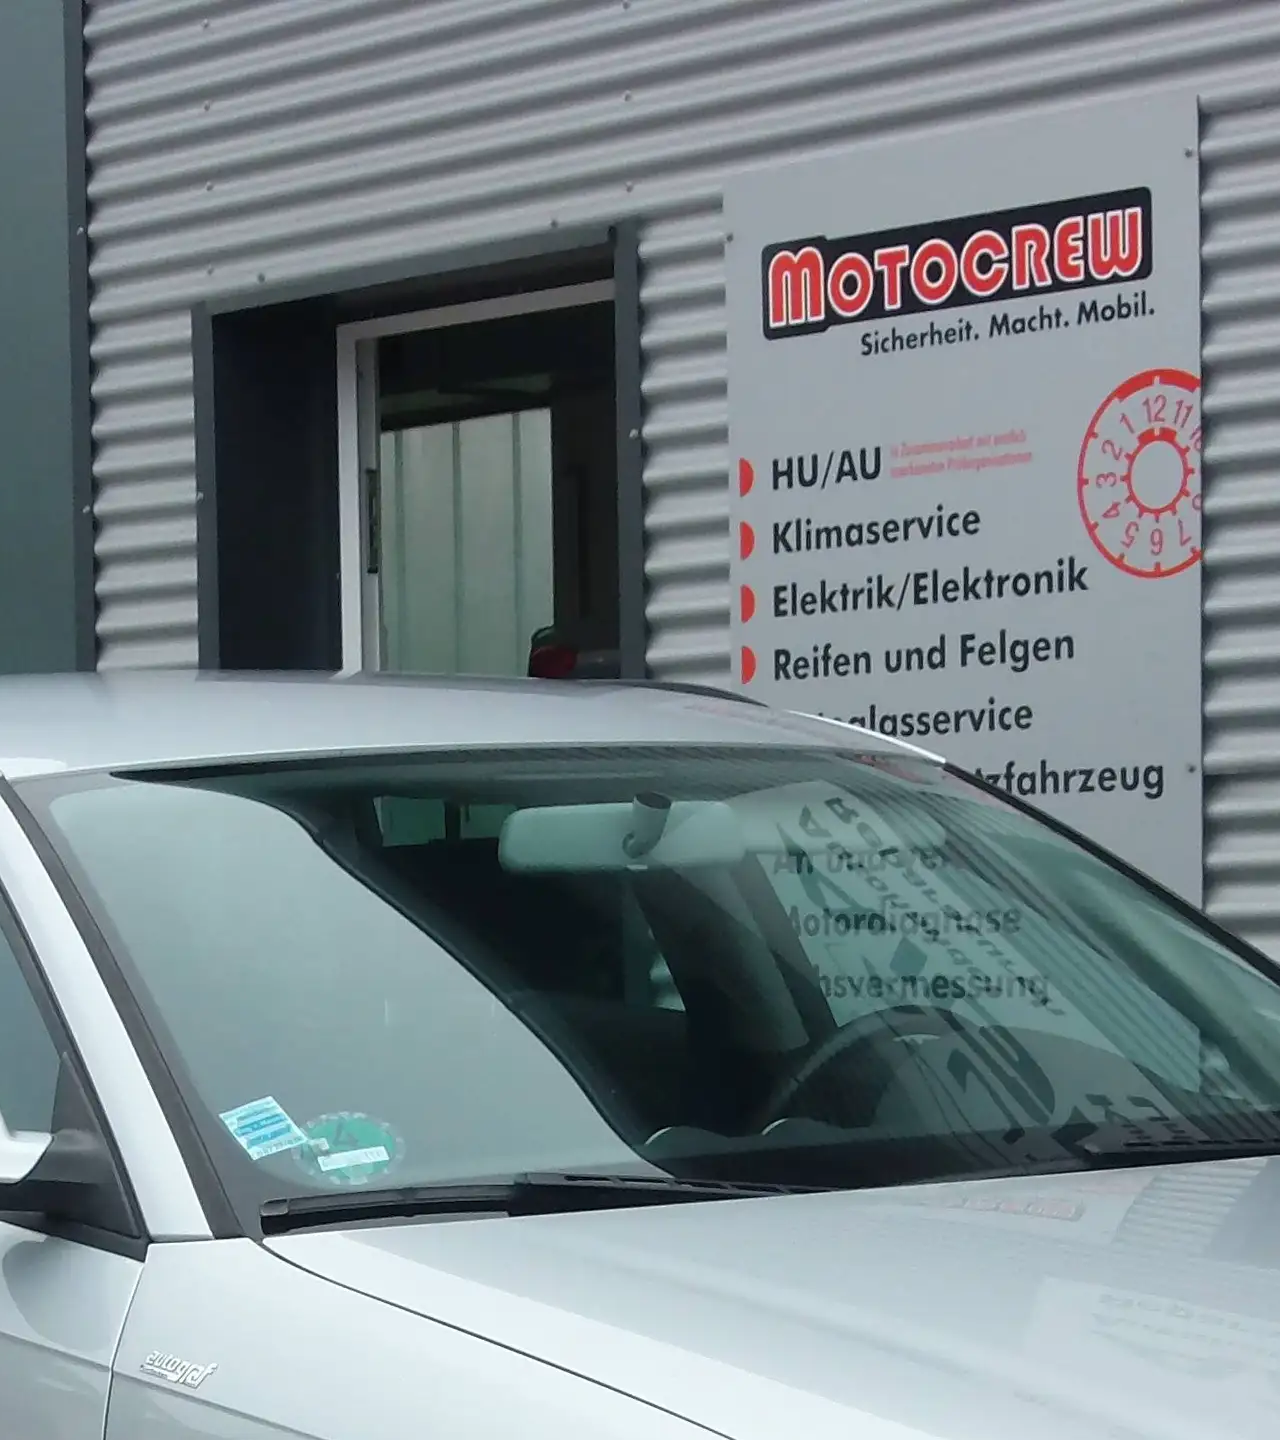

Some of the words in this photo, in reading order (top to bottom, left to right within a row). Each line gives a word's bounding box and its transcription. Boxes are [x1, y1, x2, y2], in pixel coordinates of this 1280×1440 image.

[768, 207, 1143, 328] MOTOCREW
[861, 316, 980, 357] Sicherheit.
[989, 307, 1070, 339] Macht.
[1077, 290, 1156, 325] Mobil.
[1142, 394, 1167, 424] 12
[771, 446, 882, 493] HU/AU
[772, 504, 981, 555] Klimaservice
[773, 556, 1089, 618] Elektrik/Elektronik
[773, 643, 872, 682] Reifen
[884, 634, 946, 674] und
[960, 629, 1075, 673] Felgen
